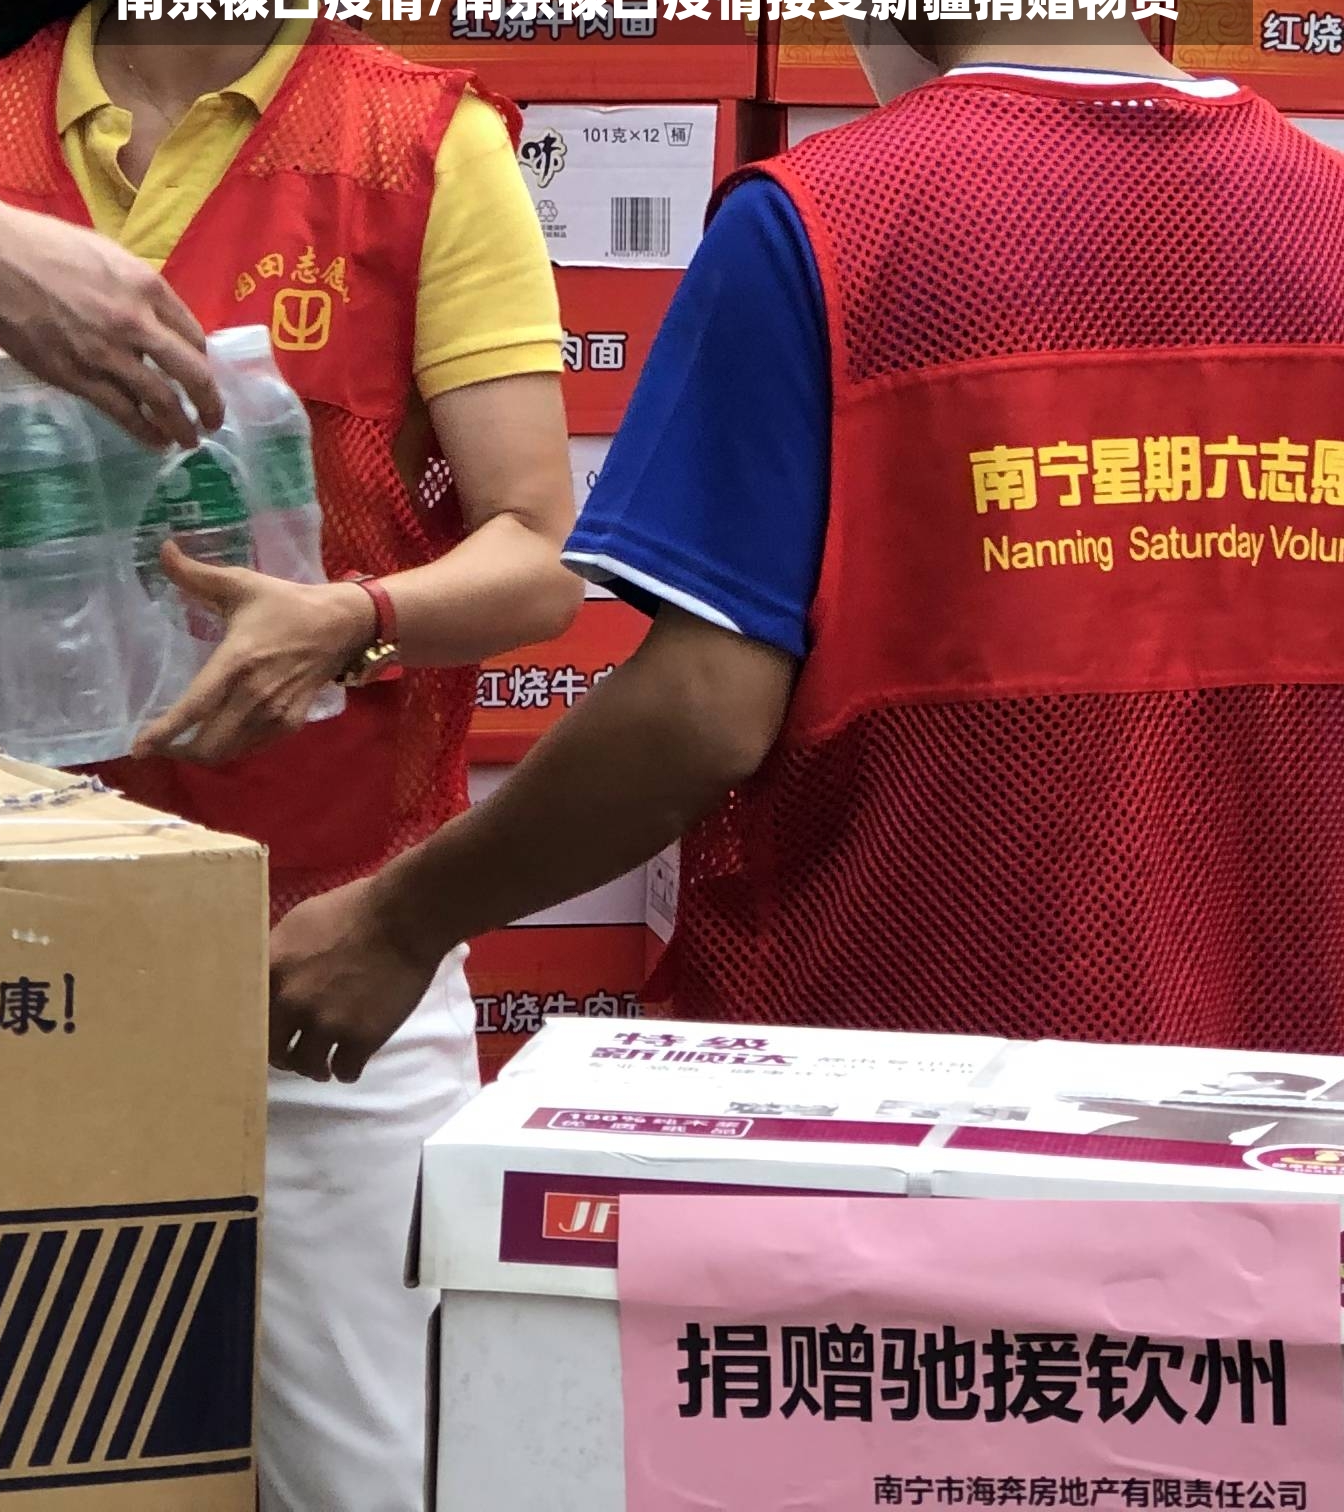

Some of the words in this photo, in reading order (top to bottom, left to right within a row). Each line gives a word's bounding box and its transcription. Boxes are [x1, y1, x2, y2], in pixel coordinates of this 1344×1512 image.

[582, 128, 660, 144] 101克×12
[235, 246, 351, 303] 国田志愿
[983, 530, 1113, 571] Nanning
[1129, 524, 1264, 566] Saturday
[475, 666, 614, 707] 红烧牛
[677, 1322, 1288, 1426] 捐赠驰援钦州
[873, 1474, 1306, 1511] 南宁市海奔房地产有限责任公司
